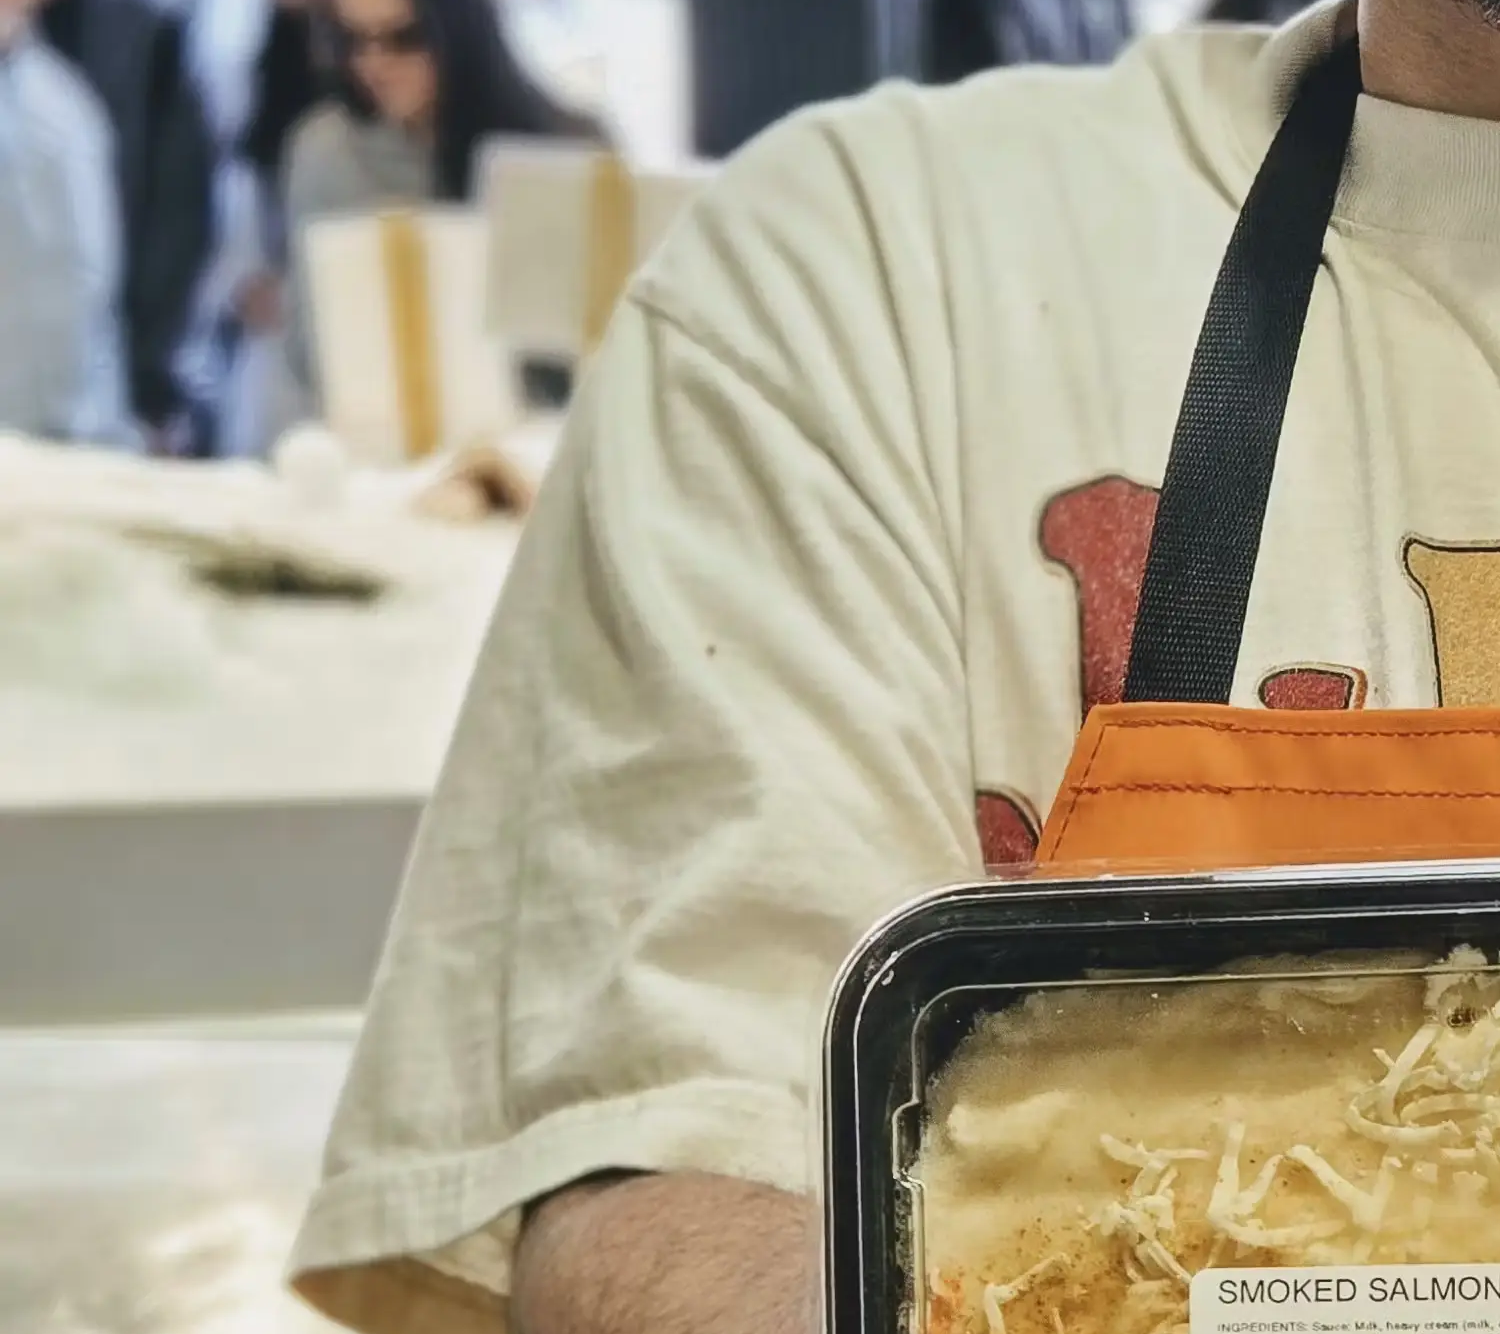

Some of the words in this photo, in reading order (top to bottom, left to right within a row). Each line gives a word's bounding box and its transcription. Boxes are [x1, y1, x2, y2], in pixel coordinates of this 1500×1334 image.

[1218, 1278, 1359, 1304] SMOKED
[1217, 1322, 1308, 1333] INGREDIENTS:
[1312, 1321, 1352, 1331] Sauce:
[1386, 1321, 1420, 1332] heavy
[1424, 1322, 1459, 1330] cream
